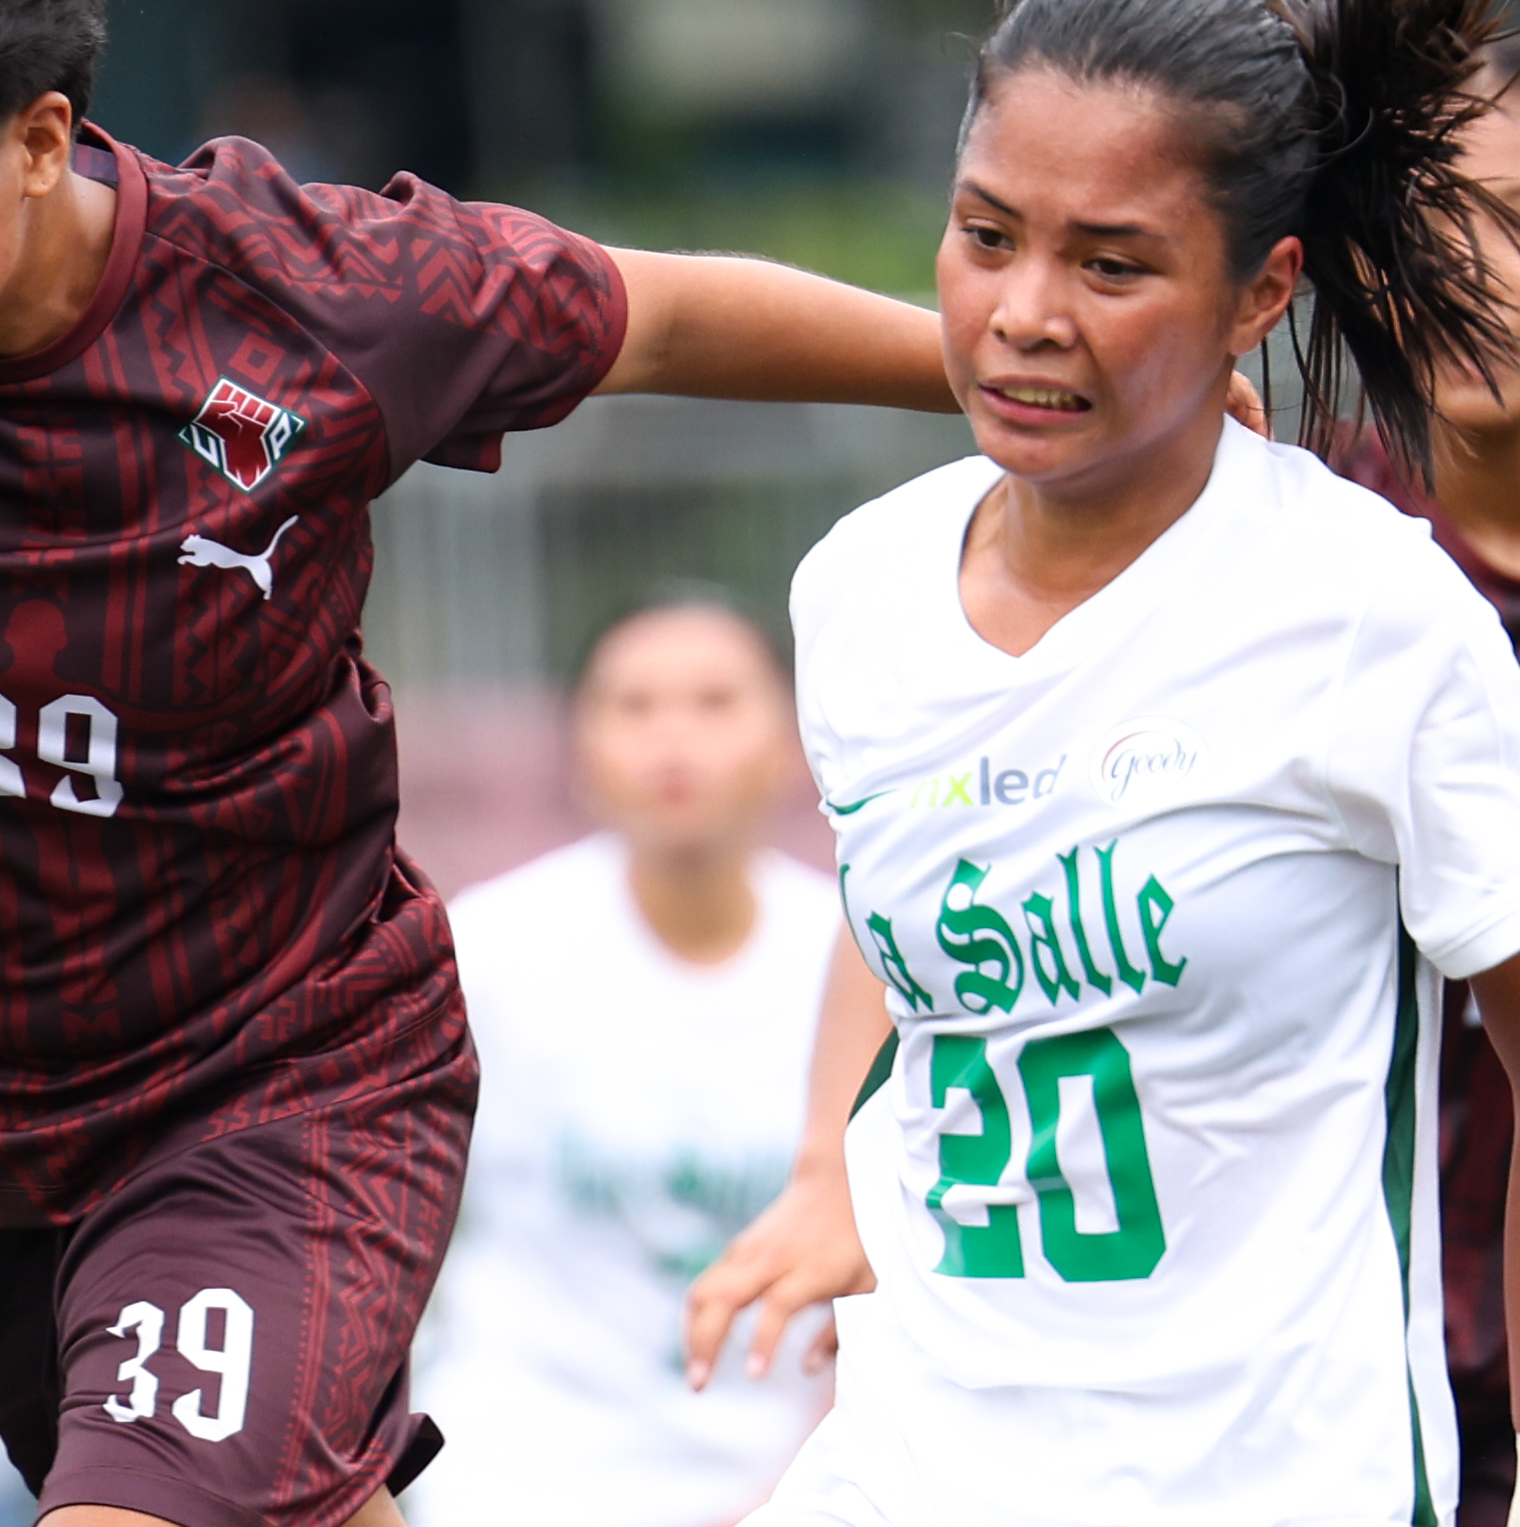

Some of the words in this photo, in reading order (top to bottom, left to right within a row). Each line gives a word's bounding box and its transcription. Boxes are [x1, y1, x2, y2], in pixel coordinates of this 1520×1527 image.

[935, 839, 1189, 1016] Salle
[922, 1027, 1168, 1285] 20
[102, 1286, 256, 1443] 39
